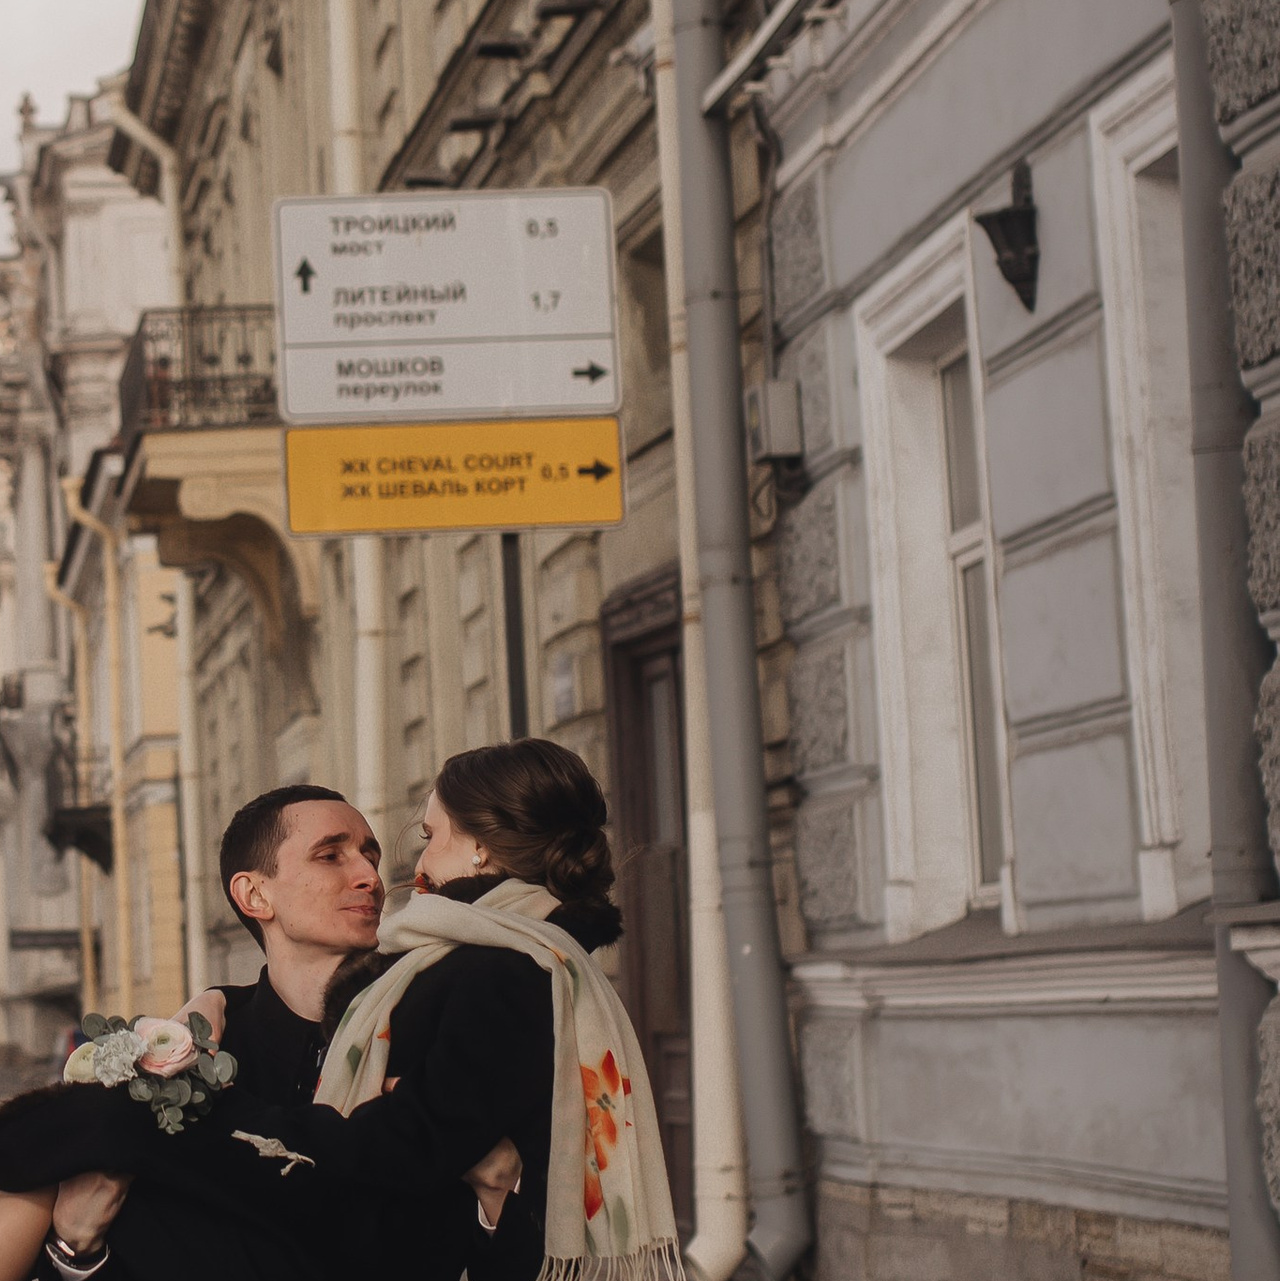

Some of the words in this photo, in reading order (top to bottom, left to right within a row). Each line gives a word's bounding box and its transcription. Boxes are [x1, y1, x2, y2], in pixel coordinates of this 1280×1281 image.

[331, 210, 456, 235] ТРОИЦКИЙ
[526, 218, 559, 240] 0,5
[331, 240, 383, 256] мост
[333, 281, 467, 307] ЛИТЕЙНЫЙ
[531, 290, 561, 314] 1,7
[334, 309, 437, 330] проспект
[336, 356, 444, 378] МОШКОВ
[337, 382, 442, 402] переулок
[341, 458, 370, 475] ЖК
[376, 454, 457, 475] CHEVAL
[463, 451, 534, 472] COURT
[342, 482, 370, 499] ЖК
[377, 478, 469, 499] ШЕВАЛЬ
[475, 476, 526, 494] КОРТ
